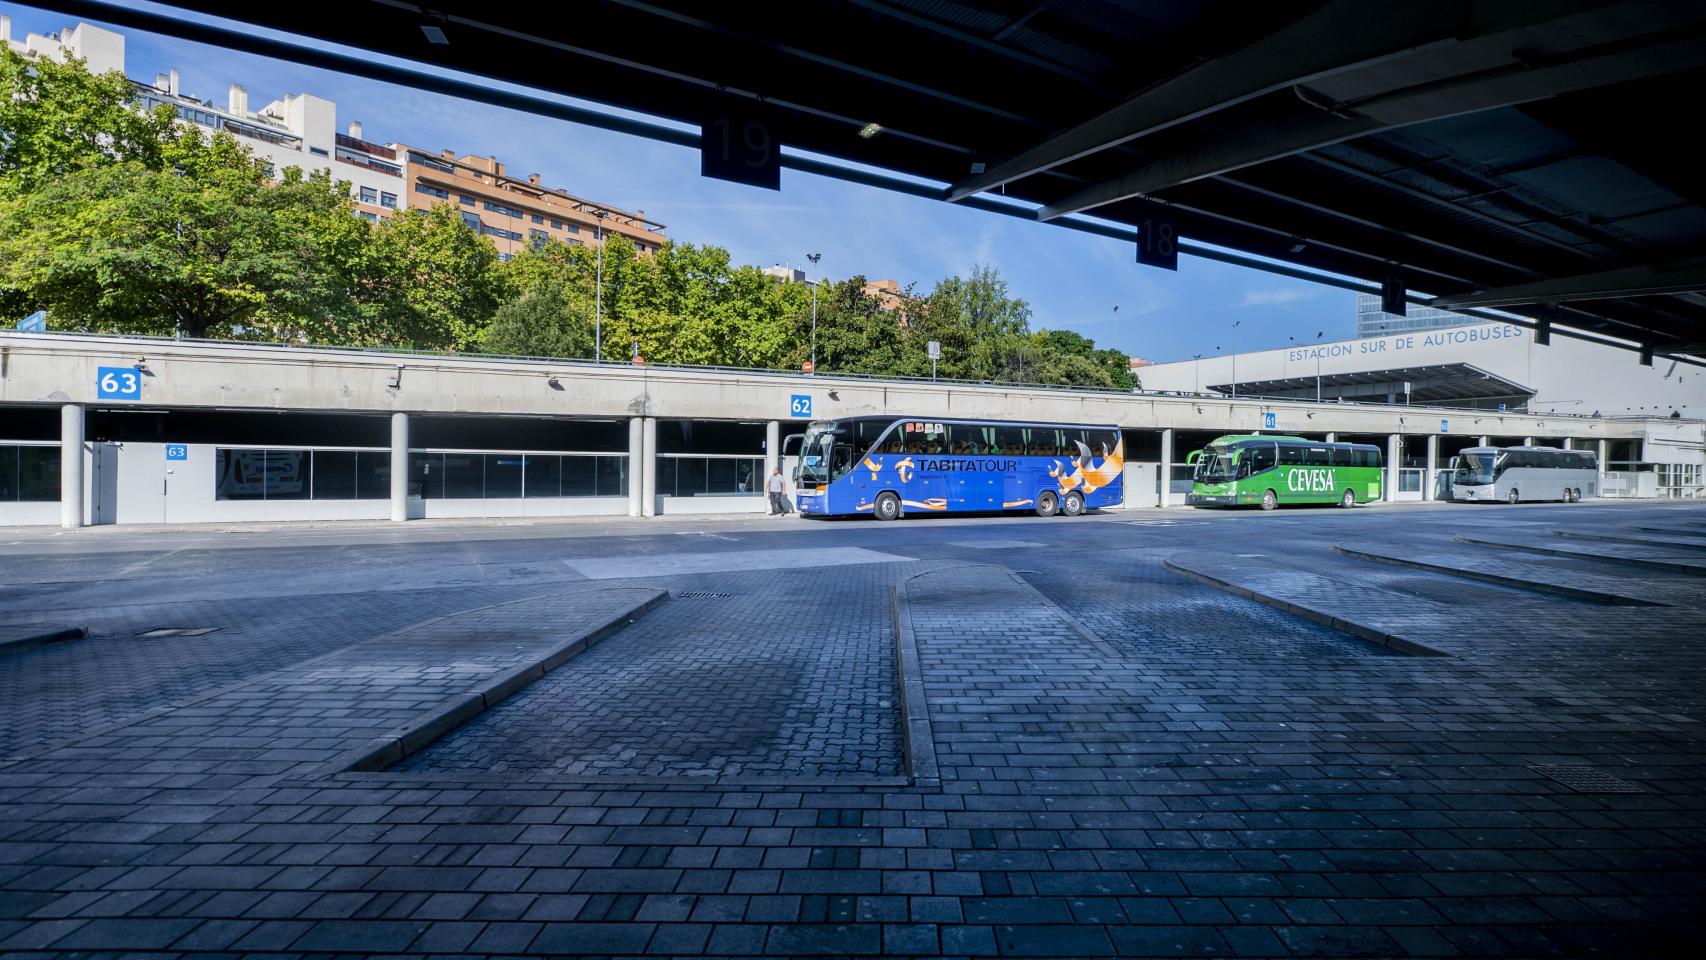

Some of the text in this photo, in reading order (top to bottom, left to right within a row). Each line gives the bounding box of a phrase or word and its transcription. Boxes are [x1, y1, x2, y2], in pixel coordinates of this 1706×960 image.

[713, 116, 770, 168] 19
[1143, 219, 1174, 257] 18
[1385, 276, 1404, 305] 17
[1361, 340, 1386, 354] SUR
[1396, 337, 1414, 349] DE
[1424, 326, 1522, 346] AUTOBUSES
[101, 372, 137, 394] 63
[793, 398, 810, 414] 62
[1267, 416, 1274, 426] 61
[168, 447, 185, 457] 63
[917, 459, 1017, 472] TABITATOUR
[1287, 468, 1334, 492] CEVESA
